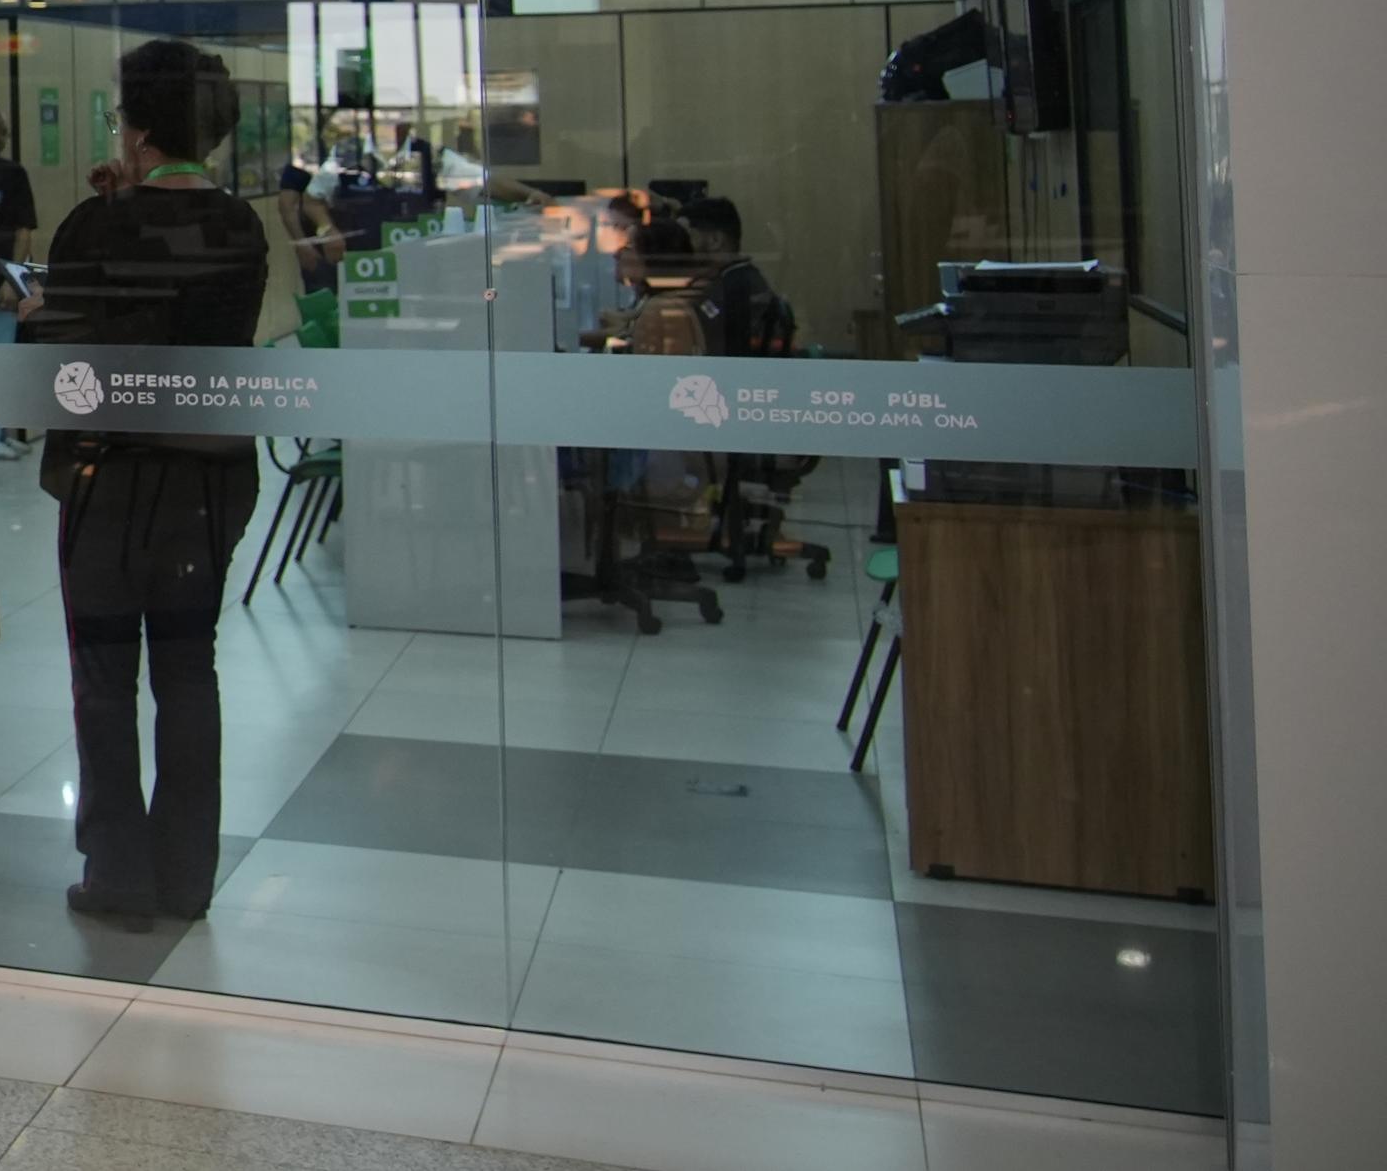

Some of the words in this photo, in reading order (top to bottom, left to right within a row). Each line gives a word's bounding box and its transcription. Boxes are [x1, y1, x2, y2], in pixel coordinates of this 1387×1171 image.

[355, 257, 386, 278] 01
[110, 391, 135, 405] DO
[201, 393, 226, 407] DO
[737, 408, 765, 422] DO
[769, 409, 844, 425] ESTADO
[847, 411, 876, 426] DO
